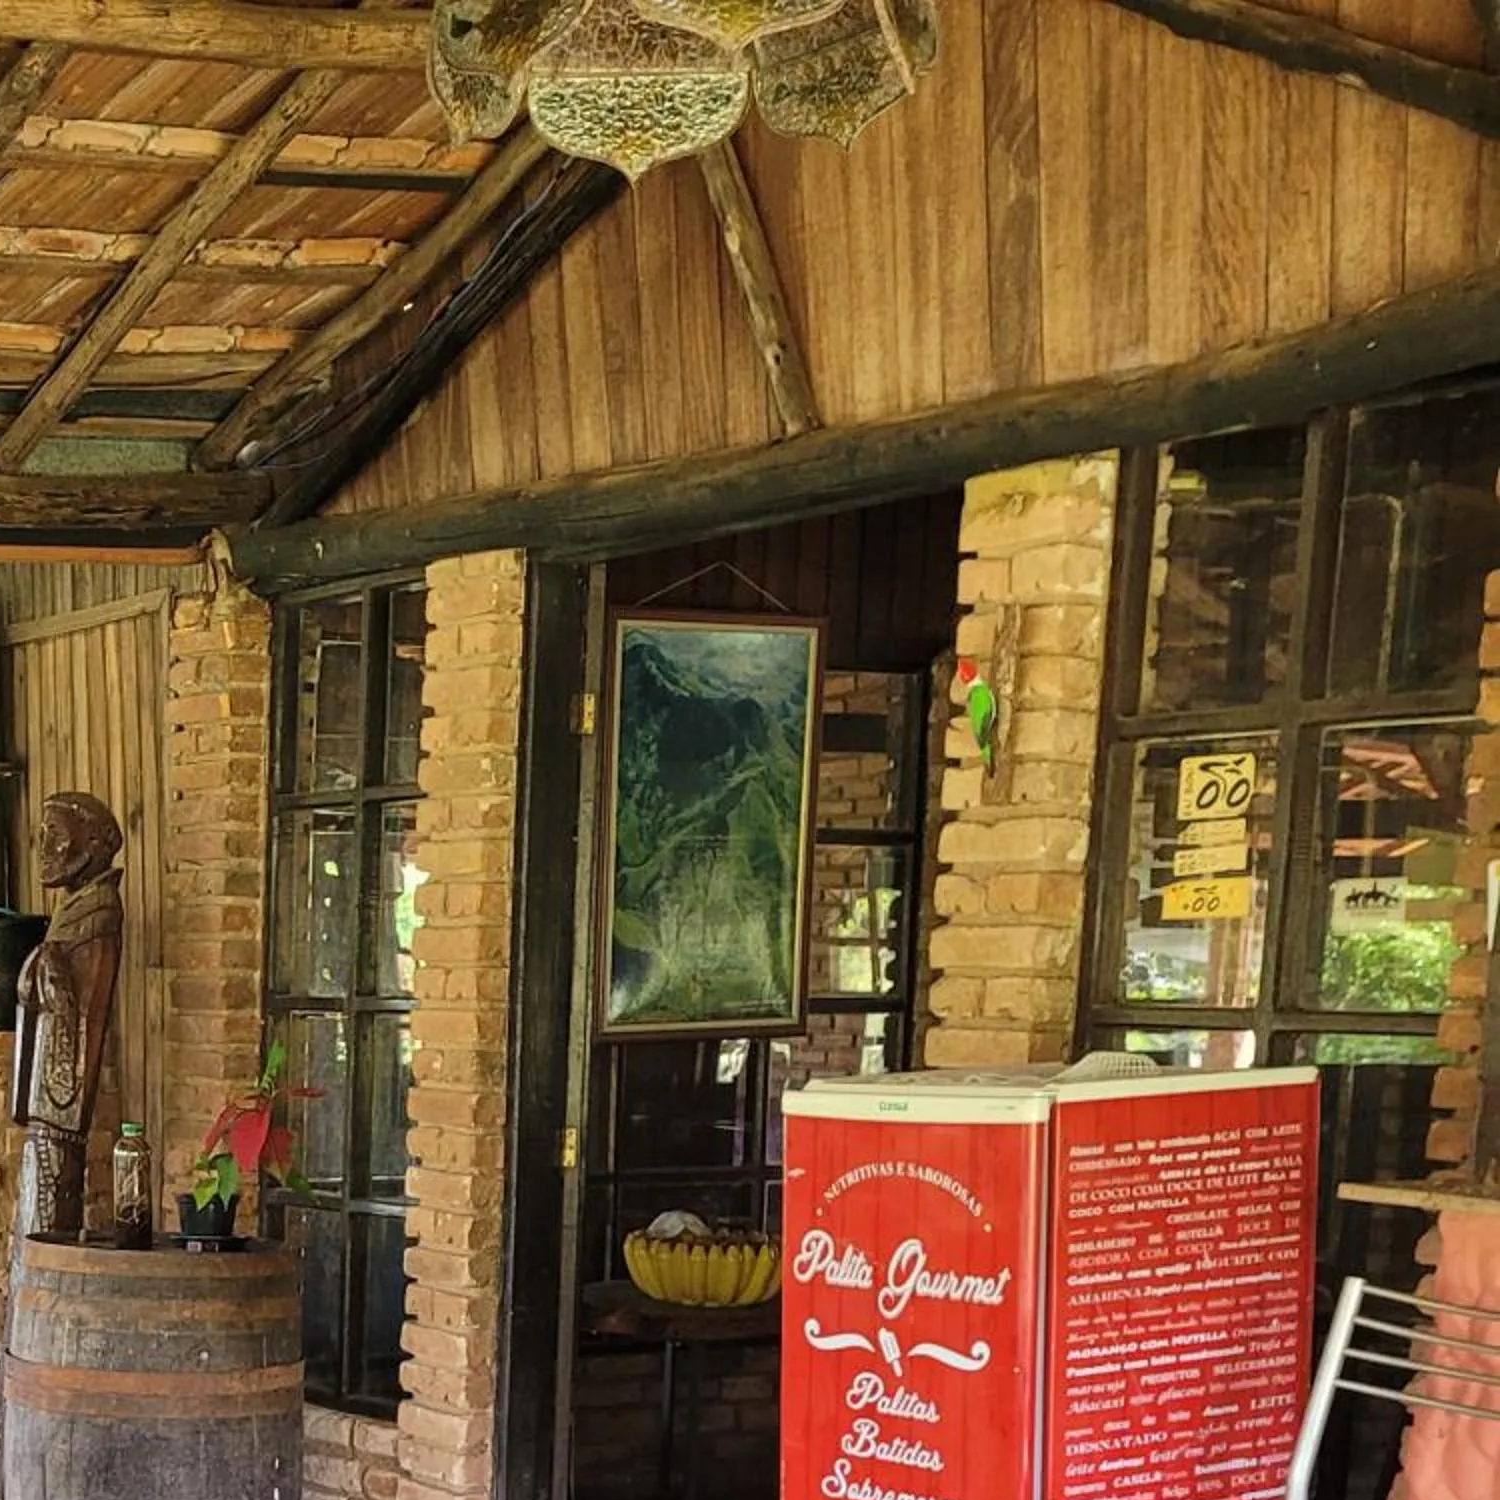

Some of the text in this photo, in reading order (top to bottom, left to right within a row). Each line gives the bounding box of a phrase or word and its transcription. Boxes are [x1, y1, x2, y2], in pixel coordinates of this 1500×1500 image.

[824, 1161, 984, 1217] NUTRITIVAS E SABOROSAS
[1070, 1191, 1088, 1204] DE
[1090, 1187, 1130, 1201] COCO
[1226, 1173, 1259, 1187] LEITE
[793, 1229, 1012, 1319] Palita Gourmet
[1067, 1342, 1138, 1360] MORANGO
[1172, 1331, 1228, 1346] NUTELLA
[845, 1371, 941, 1423] Palitas
[1250, 1393, 1296, 1410] LEITE
[841, 1418, 945, 1472] Batidas
[1066, 1432, 1168, 1456] DESNATADO
